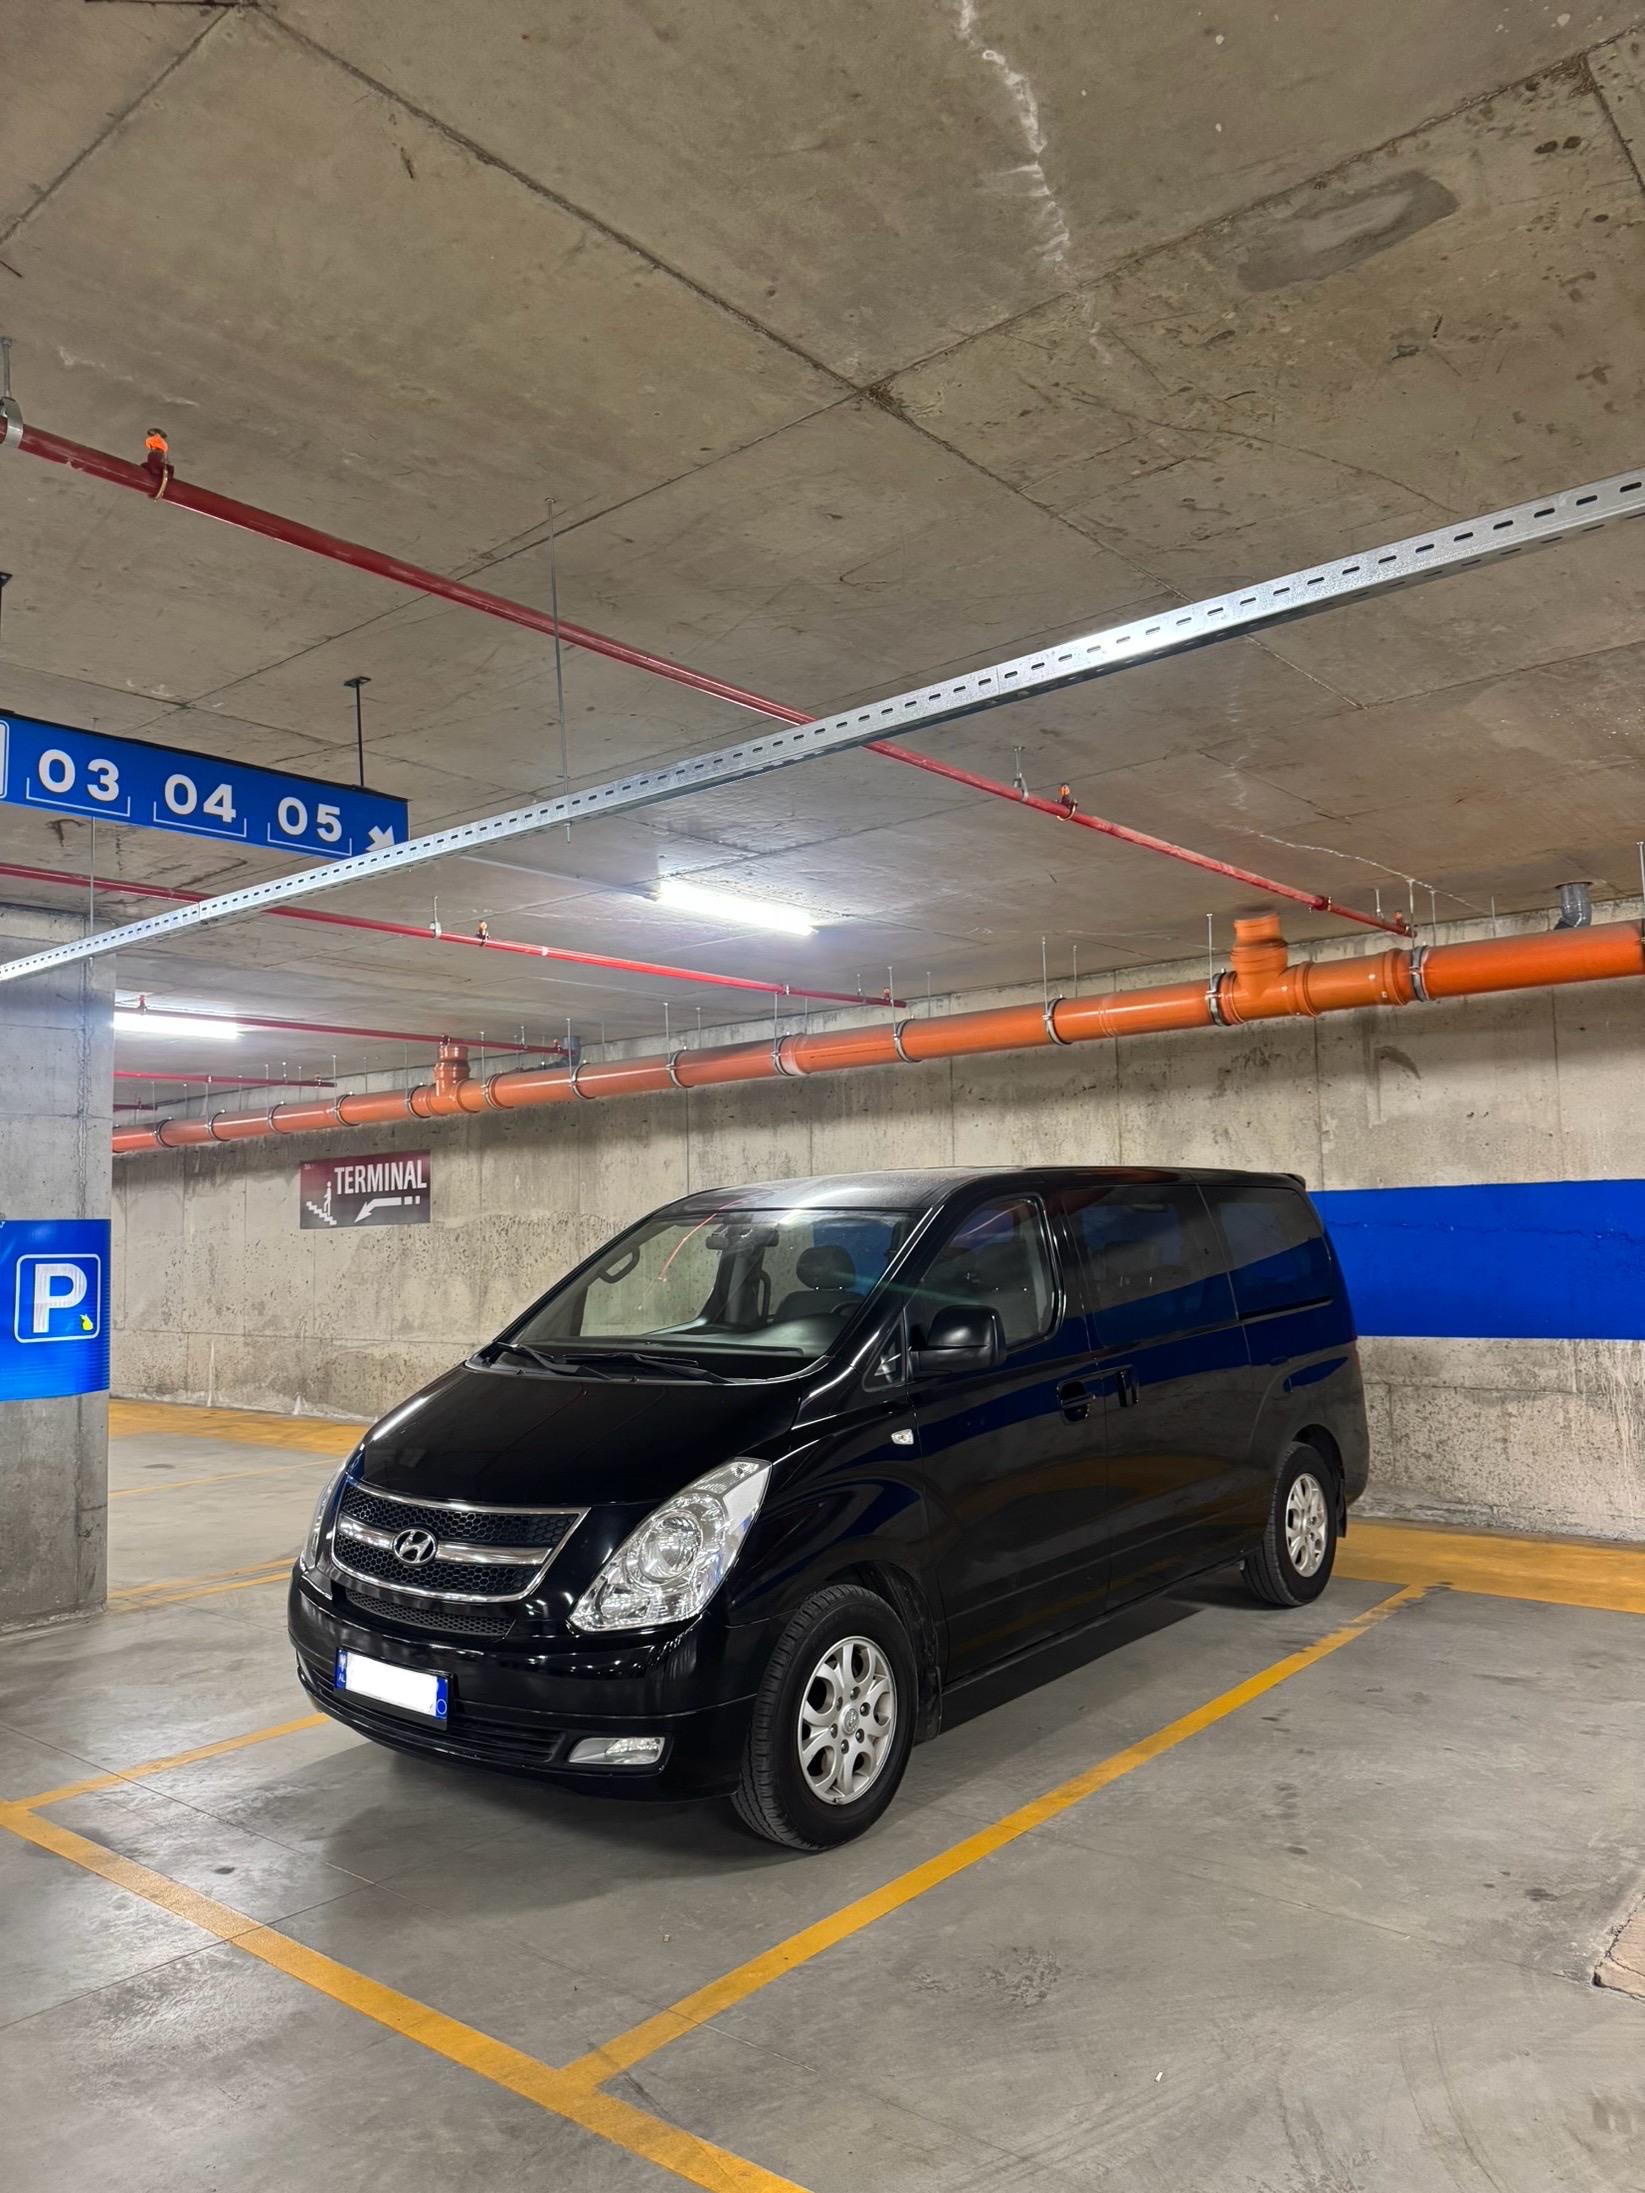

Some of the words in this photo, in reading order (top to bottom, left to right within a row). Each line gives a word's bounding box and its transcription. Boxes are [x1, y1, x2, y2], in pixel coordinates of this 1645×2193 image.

[38, 749, 120, 802] 03
[164, 774, 237, 823] 04
[277, 796, 343, 842] 05
[334, 1159, 428, 1195] TERMINAL
[33, 1263, 88, 1334] P
